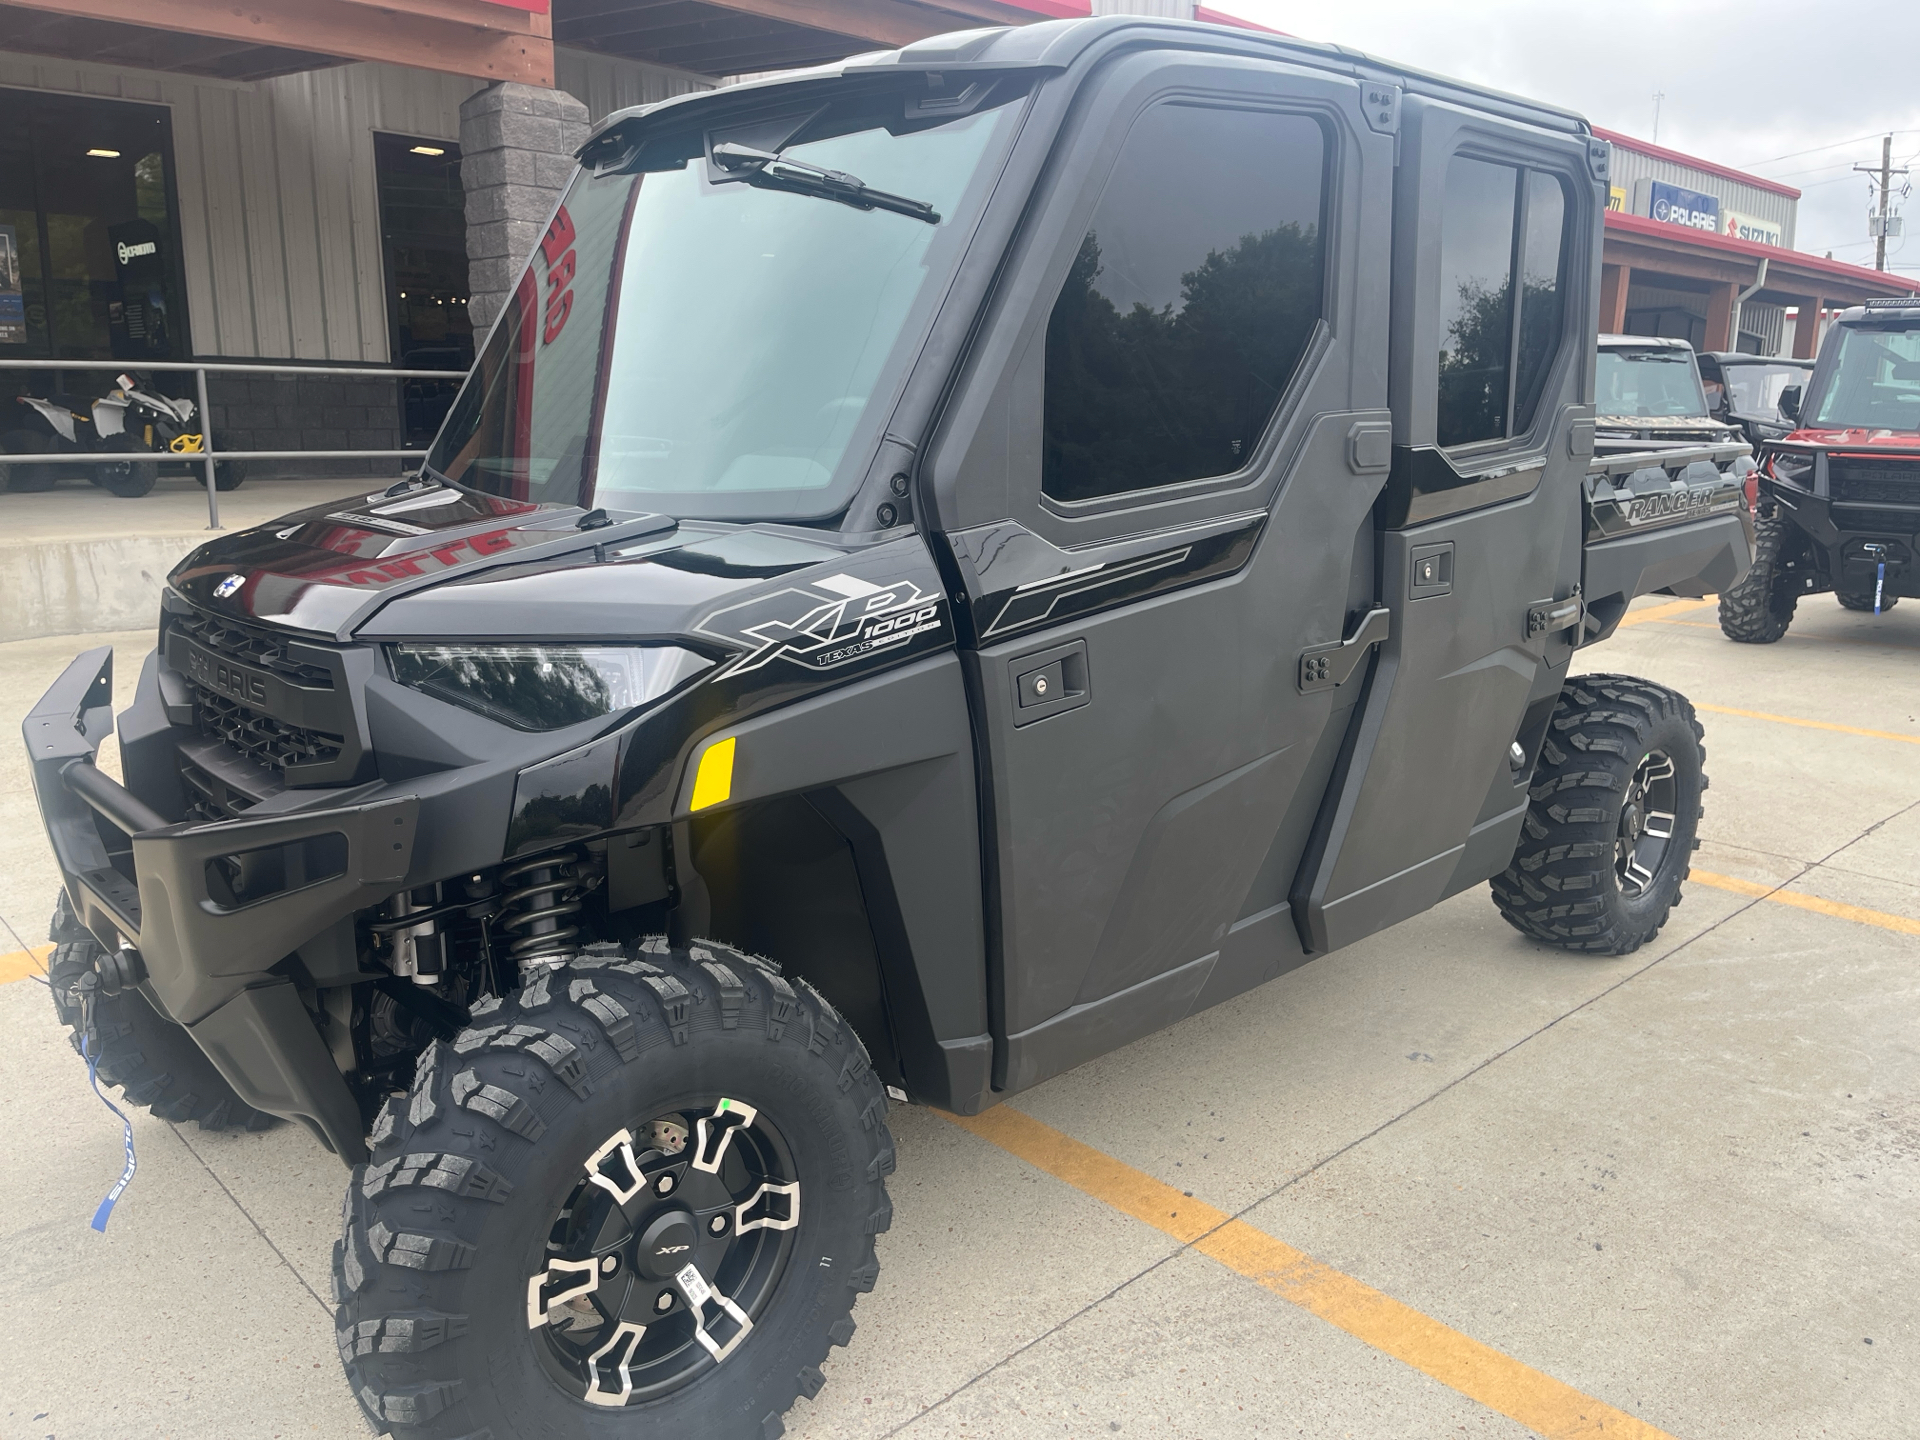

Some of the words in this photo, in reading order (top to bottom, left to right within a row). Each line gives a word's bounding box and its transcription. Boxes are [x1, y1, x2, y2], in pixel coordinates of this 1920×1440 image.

[1670, 205, 1717, 232] POLARIS
[1740, 225, 1779, 247] SUZUKI
[1627, 487, 1714, 520] RANGER
[711, 580, 941, 684] XP
[863, 605, 938, 640] 1000
[817, 640, 874, 665] TEXAS
[189, 647, 267, 708] POLARIS
[655, 1245, 690, 1255] XP
